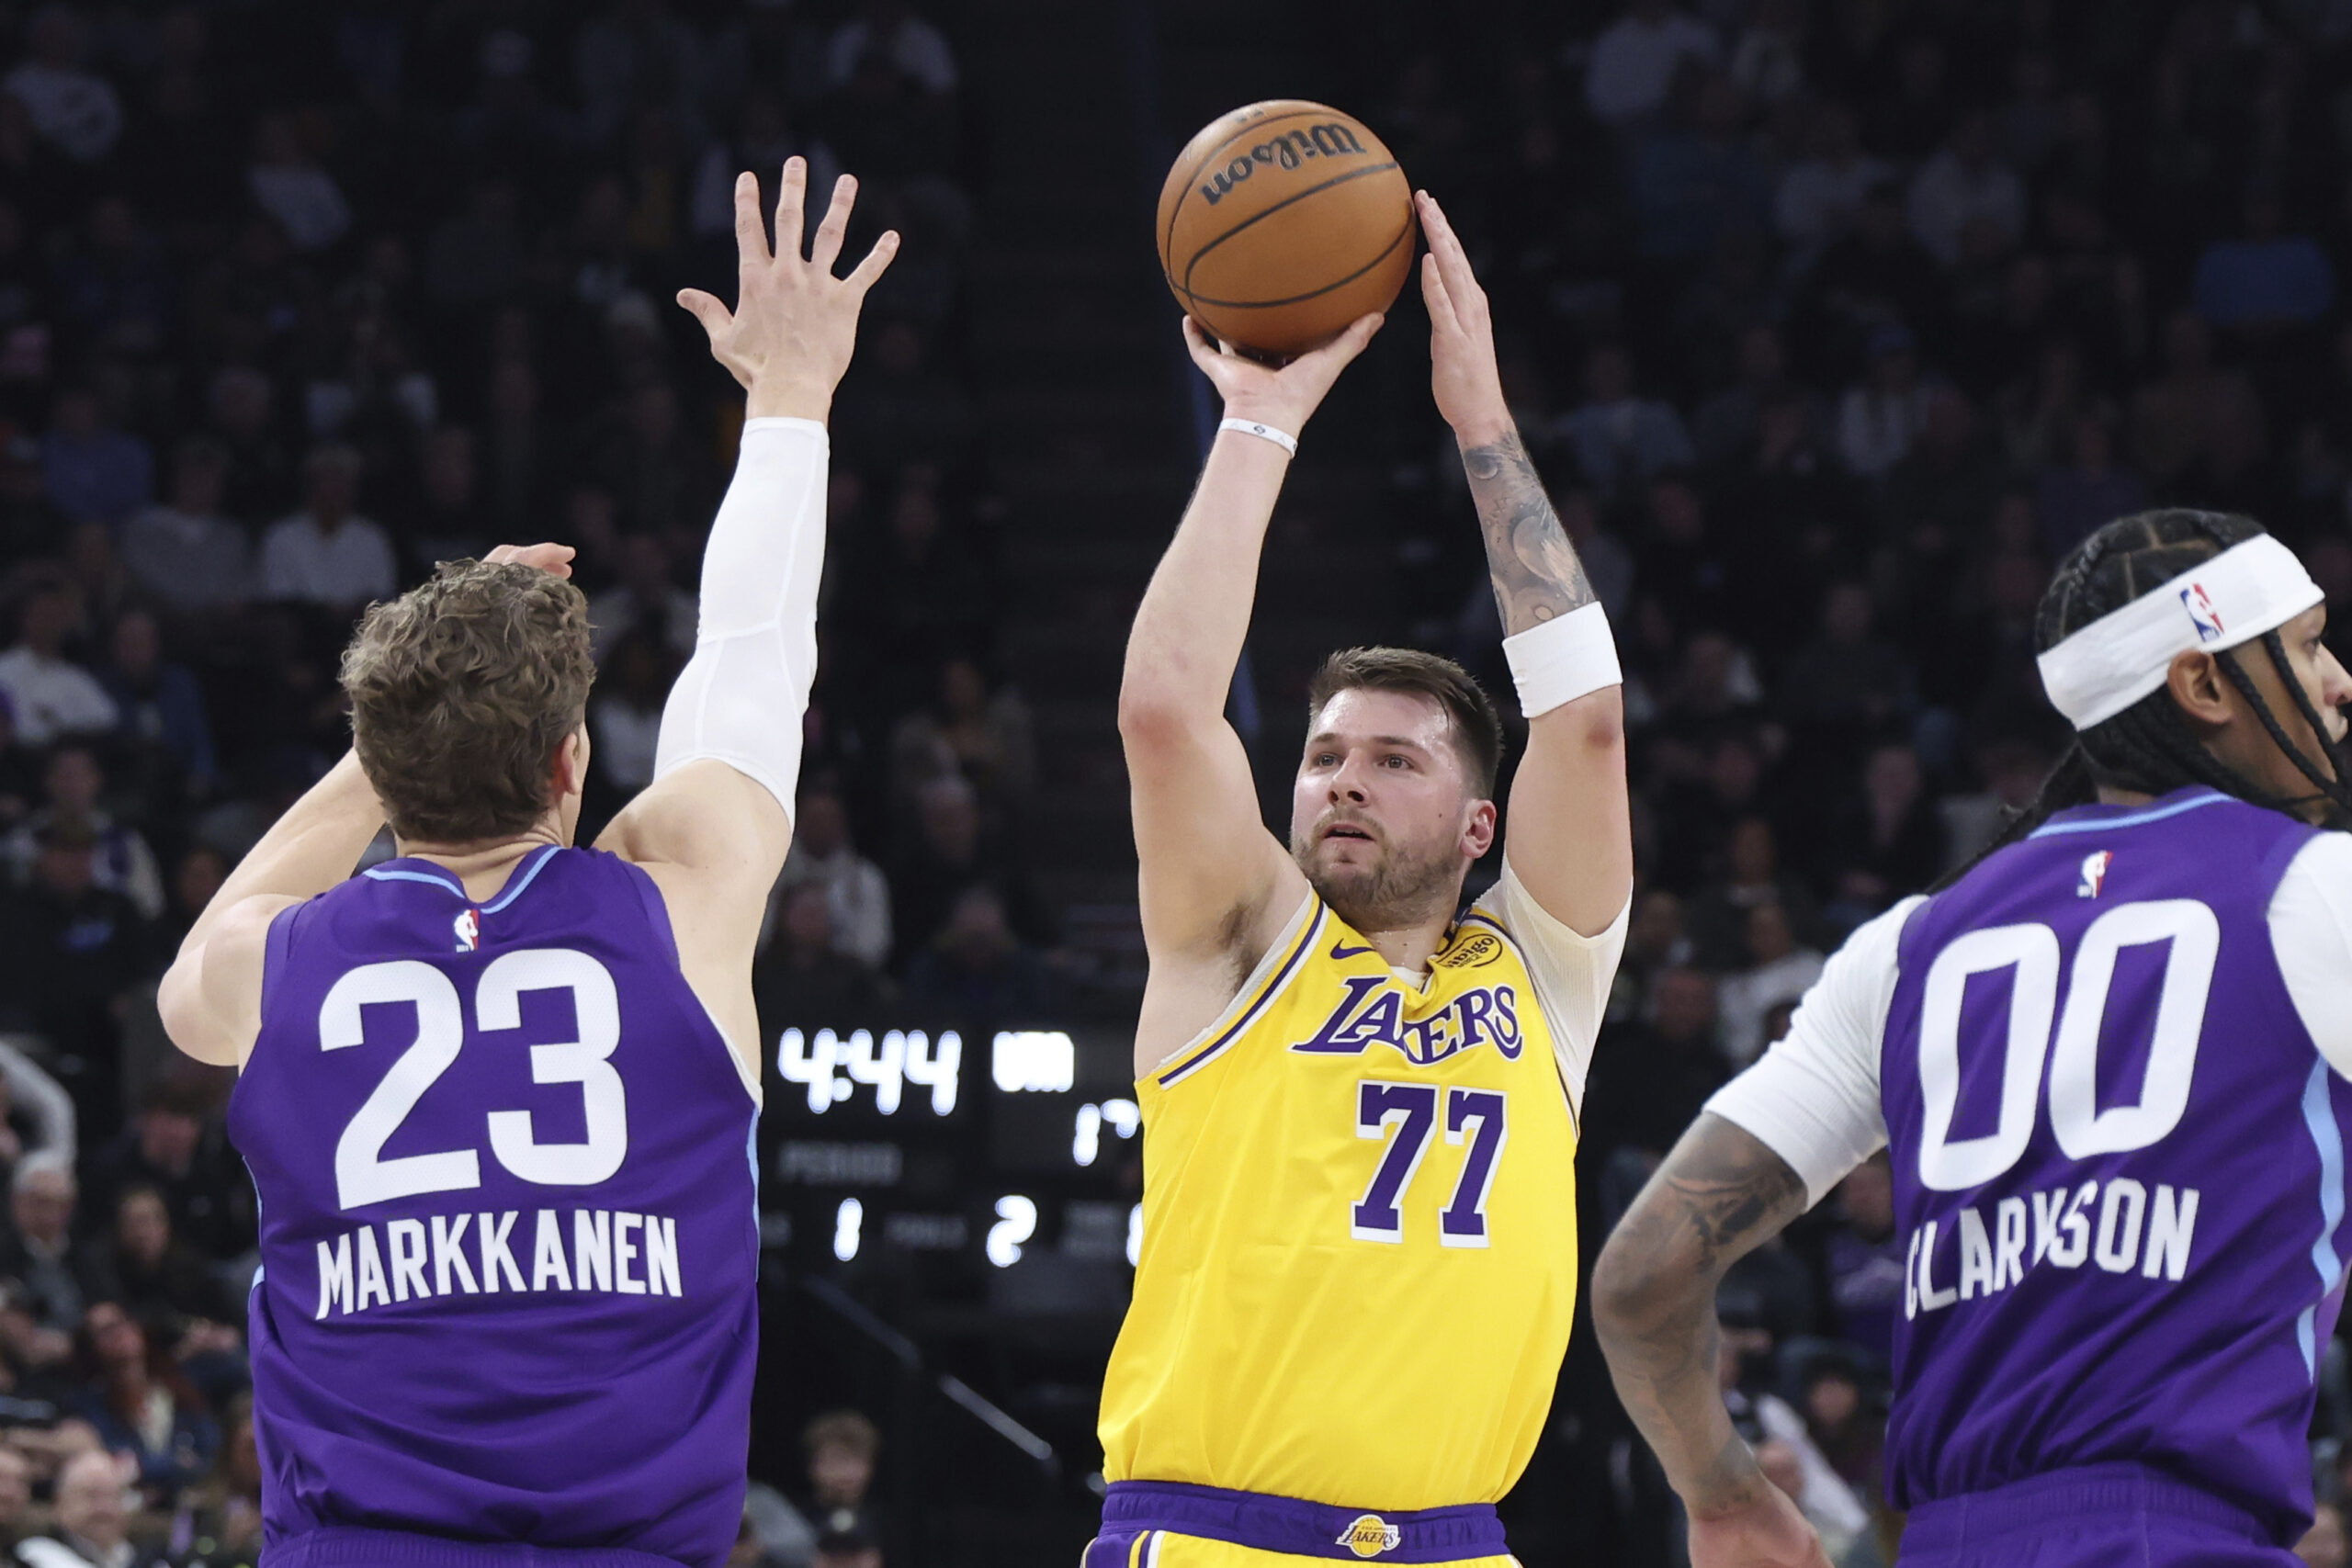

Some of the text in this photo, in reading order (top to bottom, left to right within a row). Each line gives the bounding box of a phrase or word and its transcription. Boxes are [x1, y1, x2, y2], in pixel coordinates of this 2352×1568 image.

[1199, 123, 1367, 206] Wilson
[1447, 937, 1495, 967] ibigo
[319, 948, 628, 1211] 23
[778, 1027, 962, 1116] 4:44
[1918, 898, 2221, 1191] 00
[1351, 1079, 1509, 1249] 77
[315, 1209, 683, 1321] MARKKANEN
[986, 1195, 1037, 1268] 2
[1905, 1178, 2199, 1323] CLARKSON
[1342, 1525, 1396, 1549] LAKERS
